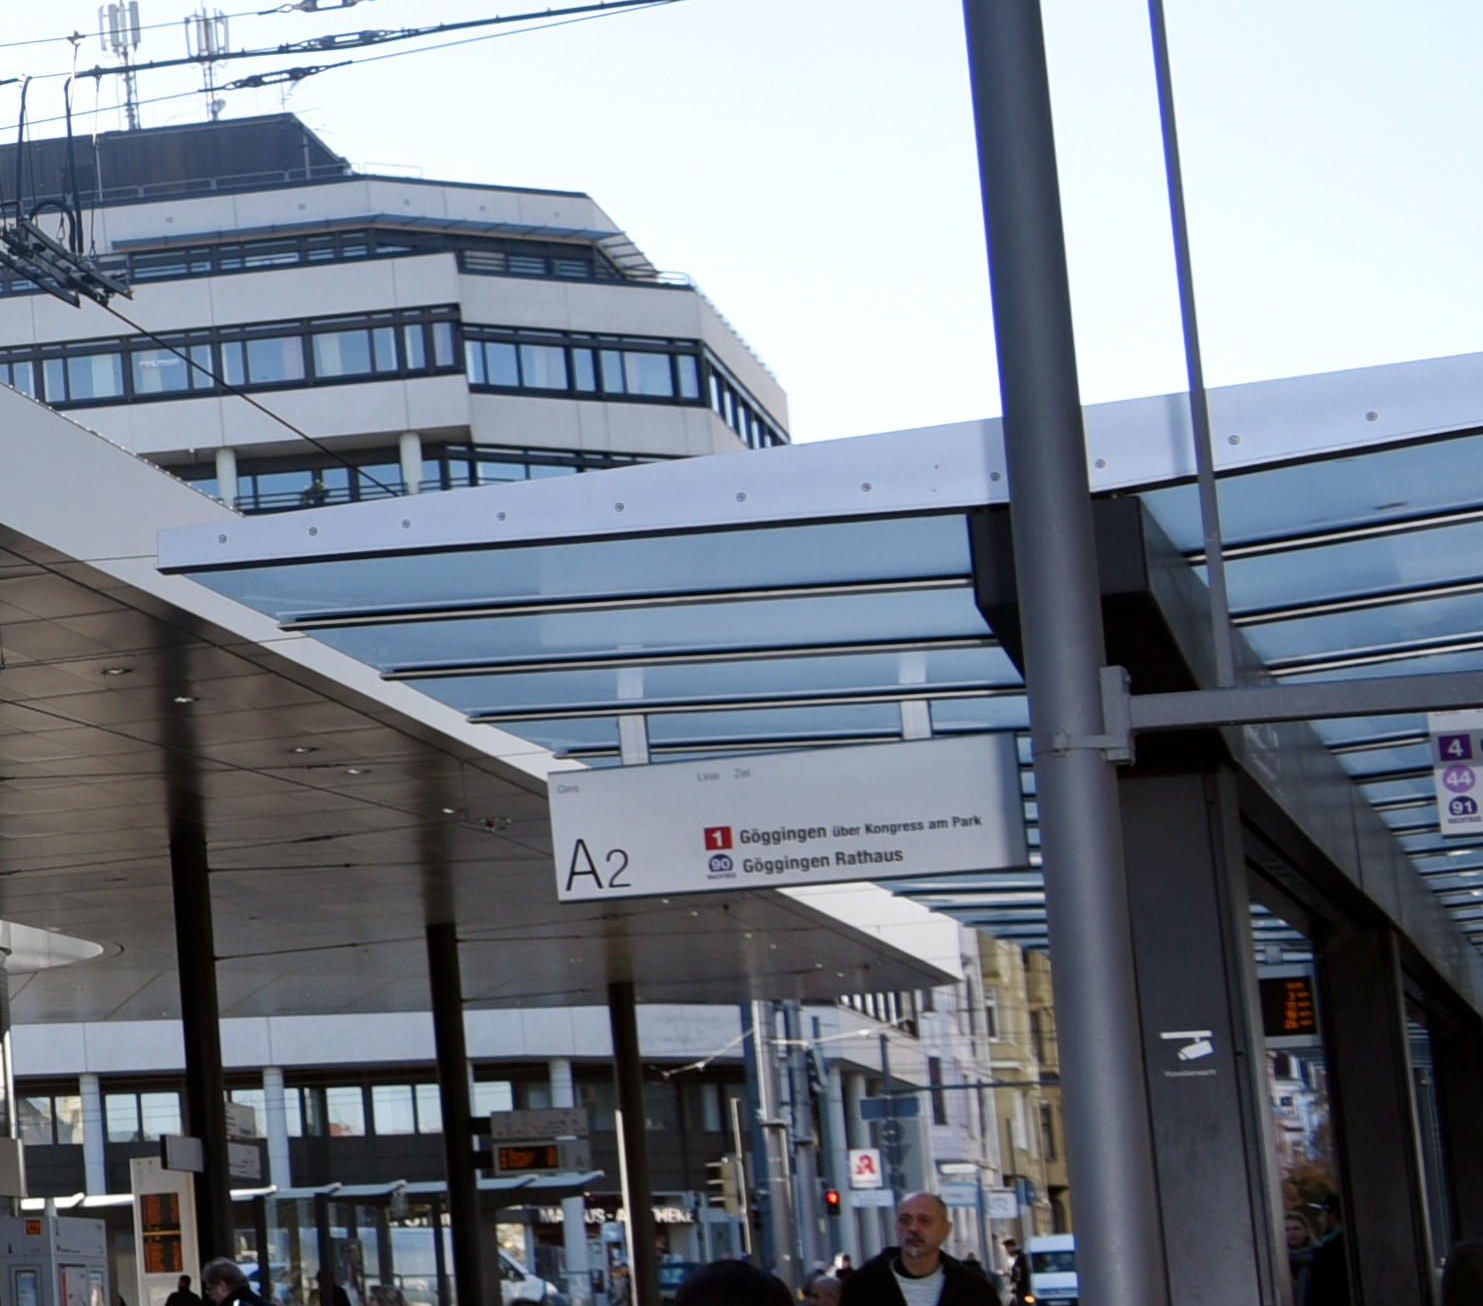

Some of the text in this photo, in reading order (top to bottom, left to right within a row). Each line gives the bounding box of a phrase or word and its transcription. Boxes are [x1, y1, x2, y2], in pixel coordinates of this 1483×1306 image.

[1448, 739, 1464, 757] 4
[698, 769, 751, 781] Linie Ziel
[1446, 770, 1472, 787] 44
[557, 785, 579, 794] Gleis
[1452, 800, 1473, 814] 91
[711, 815, 982, 848] 1 Göggingen über Kongress am Park
[566, 838, 632, 891] A2
[711, 850, 904, 875] 90 Göggingen Rathaus
